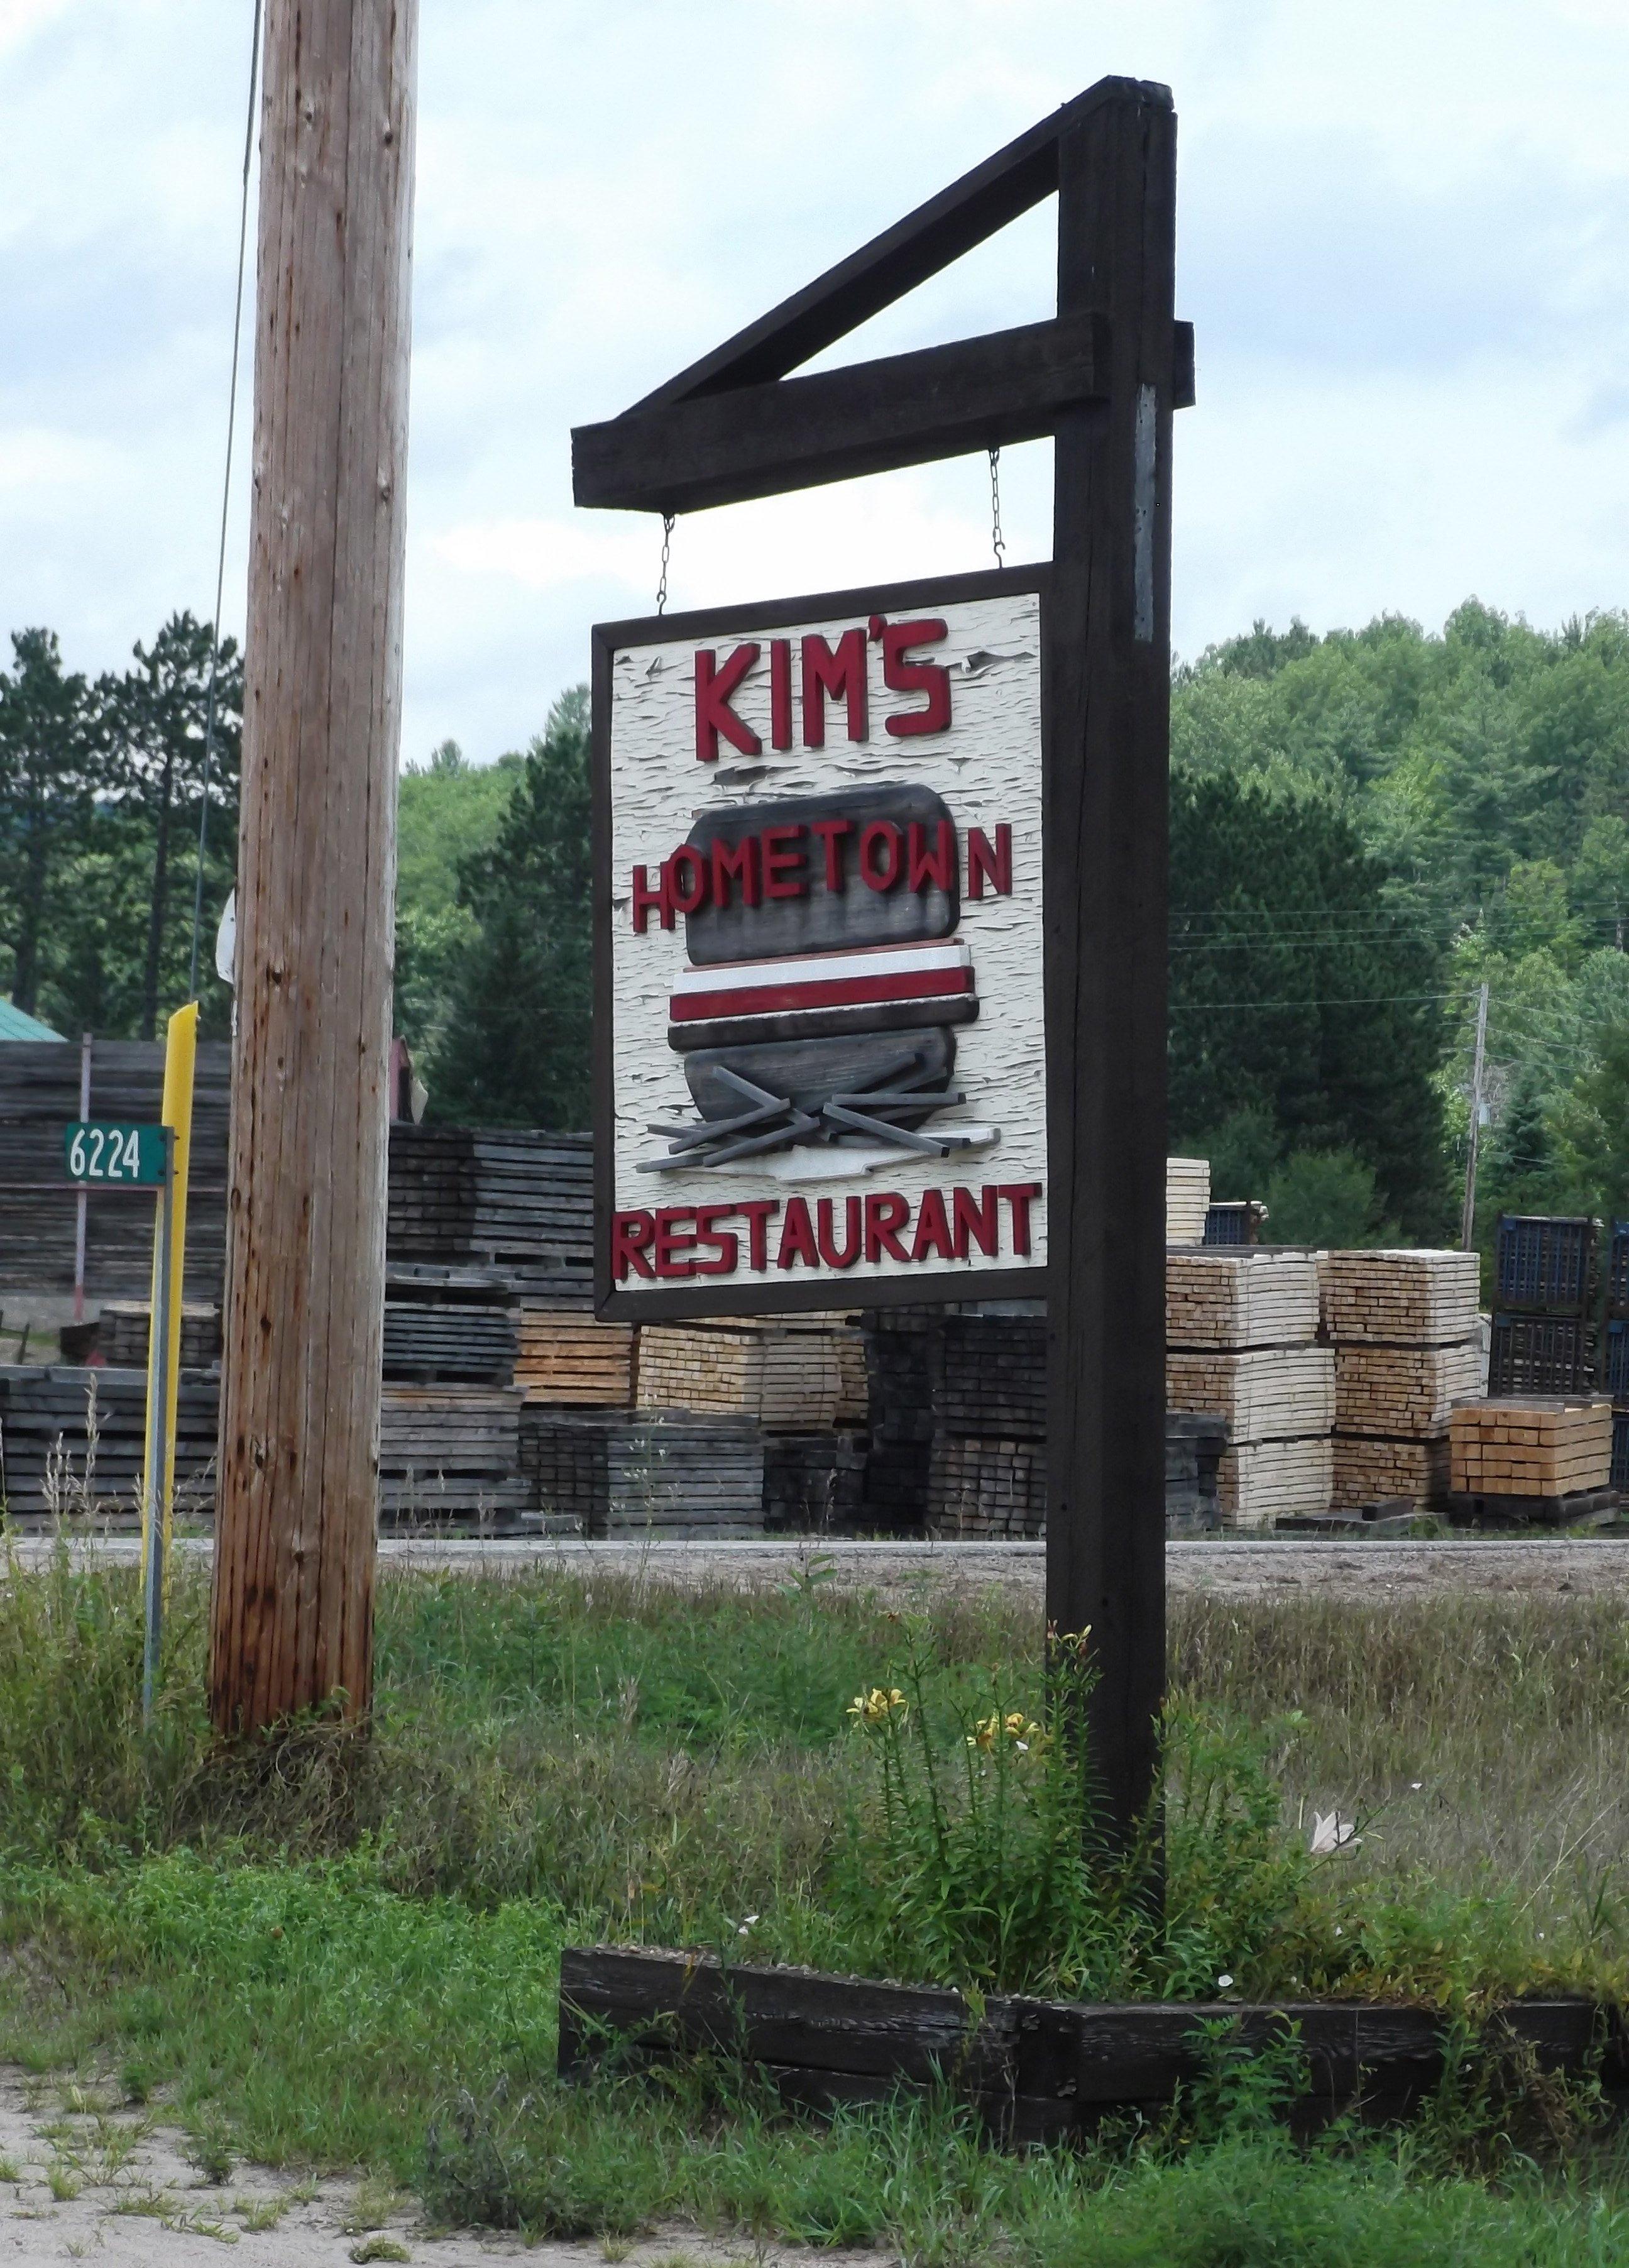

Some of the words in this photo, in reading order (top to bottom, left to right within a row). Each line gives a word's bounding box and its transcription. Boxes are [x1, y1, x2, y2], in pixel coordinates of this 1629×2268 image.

[695, 614, 952, 761] KIM'S
[633, 820, 1012, 933] HOMETOWN
[70, 1128, 140, 1178] 6224
[612, 1182, 1043, 1280] RESTAURANT
